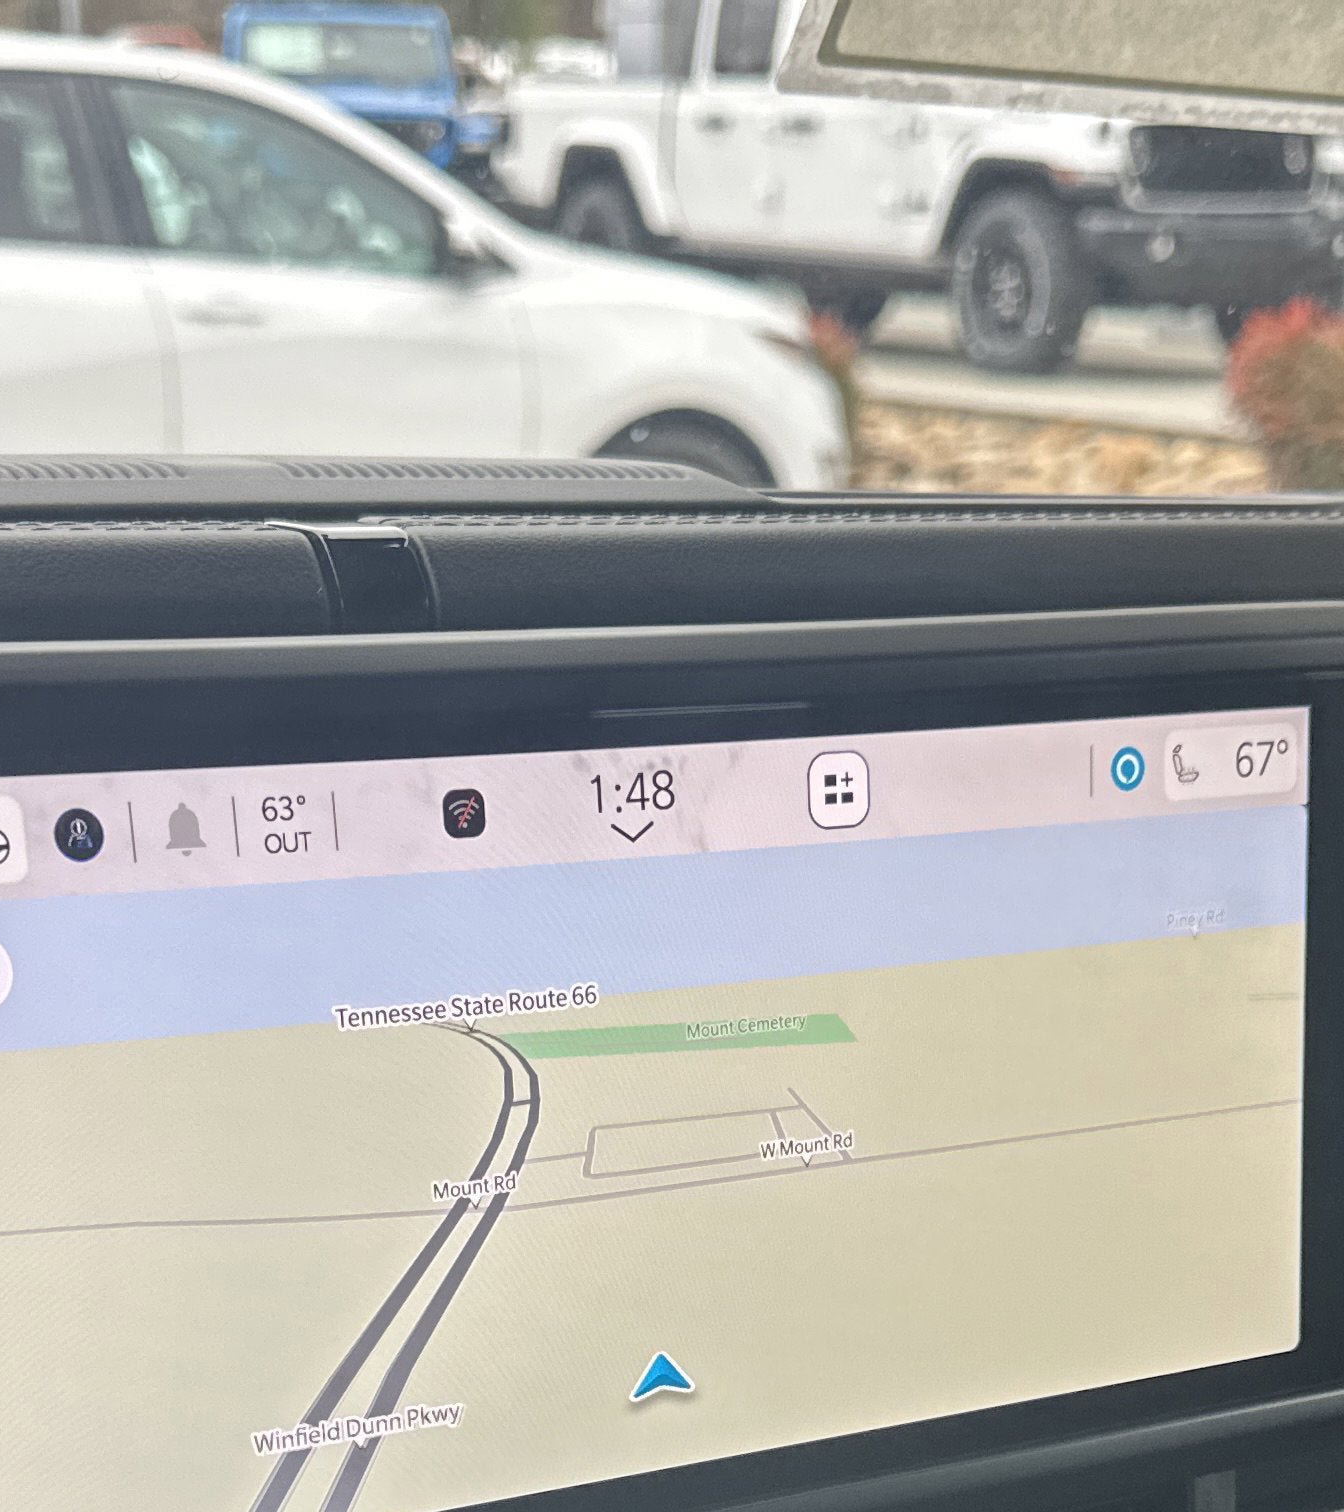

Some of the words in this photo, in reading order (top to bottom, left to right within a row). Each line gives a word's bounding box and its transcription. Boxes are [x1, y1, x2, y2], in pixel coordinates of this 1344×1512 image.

[589, 769, 676, 815] 1:48
[261, 794, 307, 822] 63°
[263, 830, 312, 856] OUT
[335, 1002, 446, 1029] Tennessee
[451, 995, 504, 1018] State
[508, 990, 566, 1013] Route
[570, 985, 598, 1008] 66
[686, 1019, 734, 1039] Mount
[737, 1014, 807, 1037] Cemetery
[761, 1143, 775, 1158] W
[778, 1138, 827, 1156] Mount
[831, 1132, 853, 1150] Rd
[433, 1178, 489, 1201] Mount
[494, 1173, 516, 1192] Rd
[254, 1421, 340, 1453] Winfield
[346, 1415, 402, 1438] Dunn
[407, 1405, 461, 1427] Pkwy
